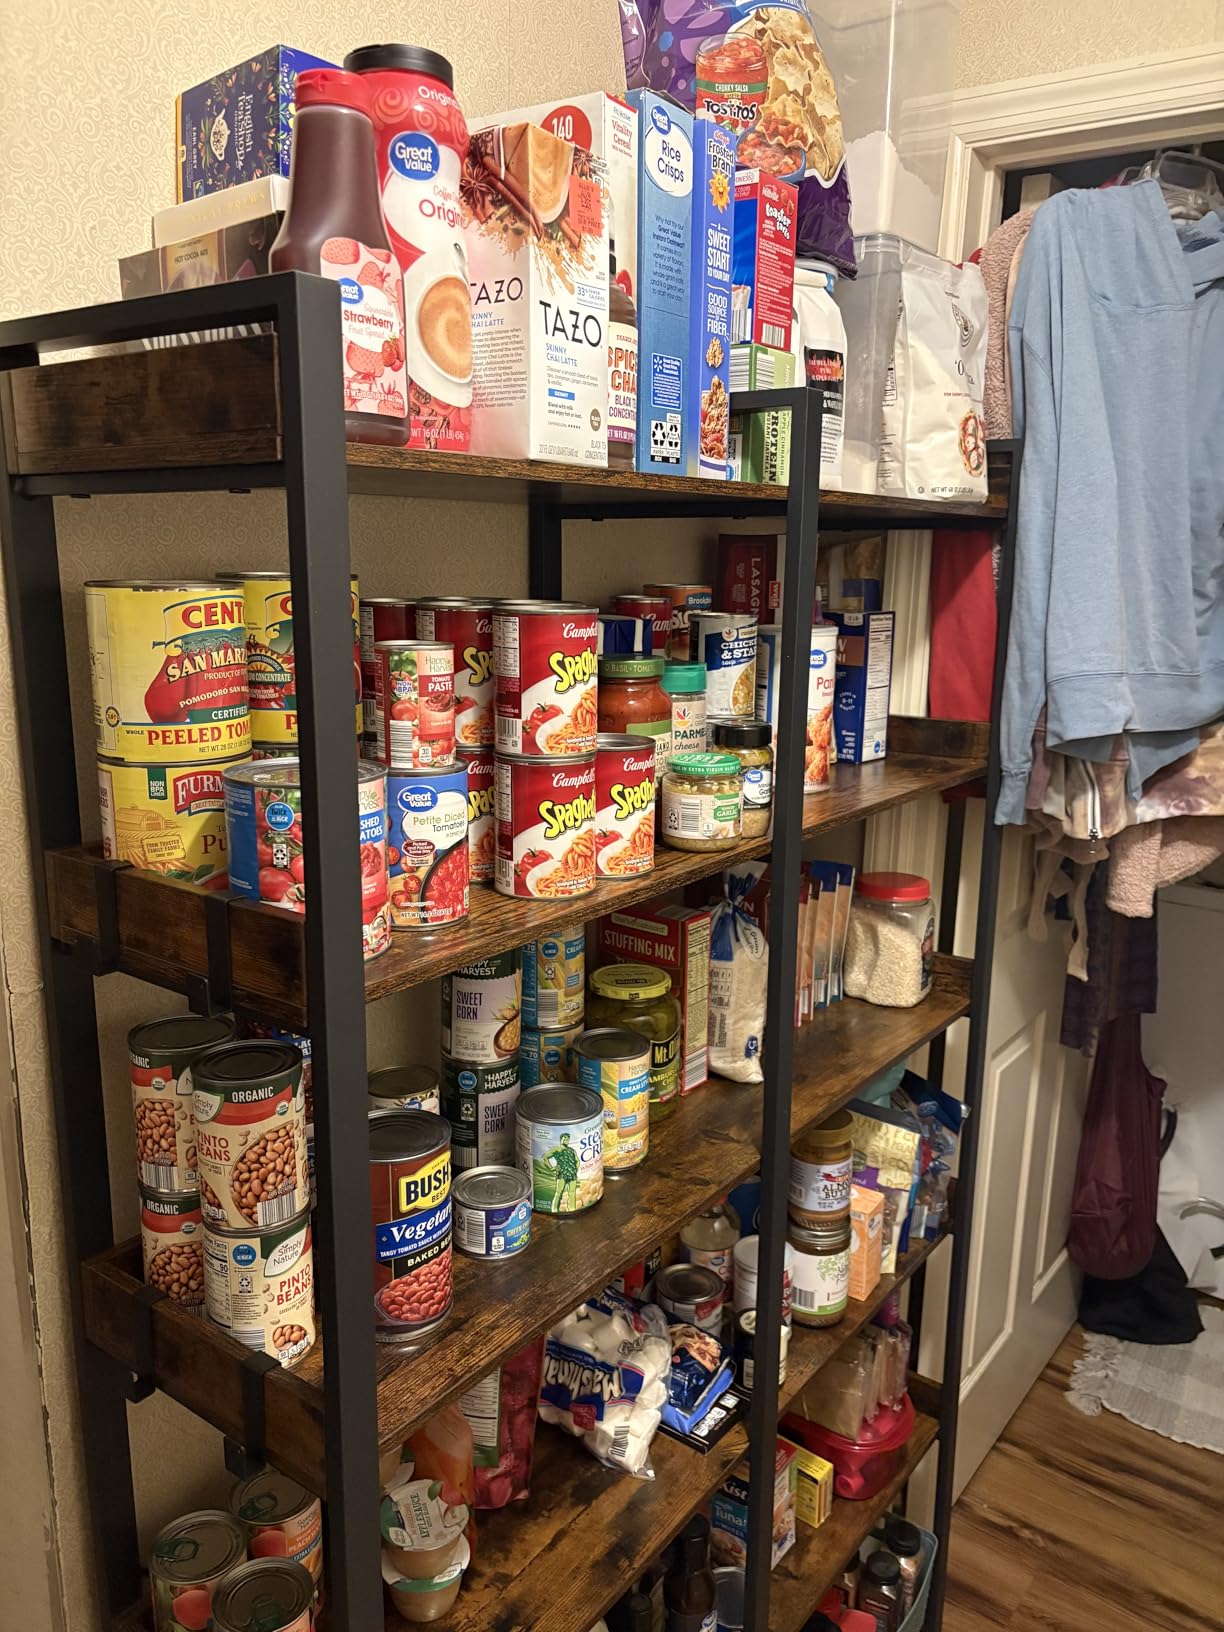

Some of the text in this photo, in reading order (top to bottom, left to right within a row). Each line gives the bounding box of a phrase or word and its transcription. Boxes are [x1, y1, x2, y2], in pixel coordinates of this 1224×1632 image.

[715, 82, 749, 92] CHUNKY SALSA
[418, 86, 459, 109] Origin
[244, 93, 255, 153] English
[551, 114, 574, 140] 140
[611, 119, 633, 142] Vitality
[613, 133, 632, 150] Cereal
[395, 142, 433, 162] Great
[661, 139, 682, 163] Rice
[707, 138, 735, 166] Frosted
[404, 158, 432, 173] Value
[657, 157, 685, 184] Crisps
[711, 156, 733, 177] Bran
[764, 202, 792, 228] toaster
[652, 231, 666, 244] Instant
[658, 224, 682, 240] Great Value
[775, 220, 791, 241] tarts
[707, 228, 731, 253] SWEET
[707, 247, 731, 273] START
[708, 292, 728, 308] GOOD
[471, 312, 494, 323] KINNY
[707, 303, 728, 319] SOURCE
[343, 308, 394, 331] Strawberry
[471, 318, 504, 331] HAI LATTE
[706, 318, 728, 337] FIBER
[545, 342, 567, 356] SKINNY
[546, 353, 578, 368] CHAI LATTE
[608, 346, 637, 372] SPIC
[611, 370, 637, 393] CHA
[615, 395, 631, 407] BLACK
[721, 650, 732, 660] &
[164, 648, 248, 687] SAN MARZ
[204, 668, 241, 681] PRODUCT OF
[611, 665, 629, 674] BASIL
[255, 672, 292, 683] CONCENTRATE
[431, 675, 451, 684] TOMATO
[816, 676, 834, 692] Pan
[398, 686, 413, 694] BPA
[428, 681, 453, 693] PASTE
[179, 685, 240, 709] POMODORO SAN
[126, 729, 145, 737] WHOLE
[147, 724, 222, 747] PEELED
[199, 742, 234, 754] NET WT 28 OZ
[674, 741, 700, 752] cheese
[176, 772, 225, 808] FURM
[402, 791, 432, 803] Great
[271, 808, 288, 816] TWICE
[413, 811, 465, 827] Petite Diced
[716, 809, 739, 818] GARLIC
[360, 816, 380, 831] SHED
[432, 819, 466, 834] Tomatoes
[360, 825, 383, 841] ATOES
[147, 846, 163, 855] FAMILY
[159, 839, 180, 848] TRUSTED
[604, 930, 676, 962] STUFFING MIX
[457, 964, 497, 977] HARVEST
[456, 990, 483, 1007] SWEET
[456, 1005, 479, 1021] CORN
[529, 1051, 538, 1059] 70
[654, 1044, 668, 1065] Mt.
[484, 1074, 518, 1091] HARVEST
[487, 1068, 513, 1082] HAPPY
[231, 1085, 275, 1104] ORGANIC
[484, 1101, 510, 1120] SWEET
[484, 1117, 507, 1134] CORN
[404, 1165, 451, 1207] BUSH
[431, 1188, 446, 1204] BEST
[146, 1199, 179, 1216] ORGANIC
[214, 1241, 228, 1251] Facts
[277, 1240, 303, 1259] Simply
[379, 1247, 397, 1258] TANGY
[397, 1243, 417, 1255] TOMATO
[418, 1238, 433, 1249] SAUCE
[273, 1250, 299, 1268] Nature
[407, 1245, 440, 1268] BAKED
[219, 1264, 229, 1273] 90
[279, 1263, 312, 1293] PINTO
[276, 1277, 312, 1306] BEANS
[409, 1492, 431, 1540] APPLESAUCE
[288, 1534, 311, 1554] PEACH
[294, 1549, 309, 1562] EXTRA
